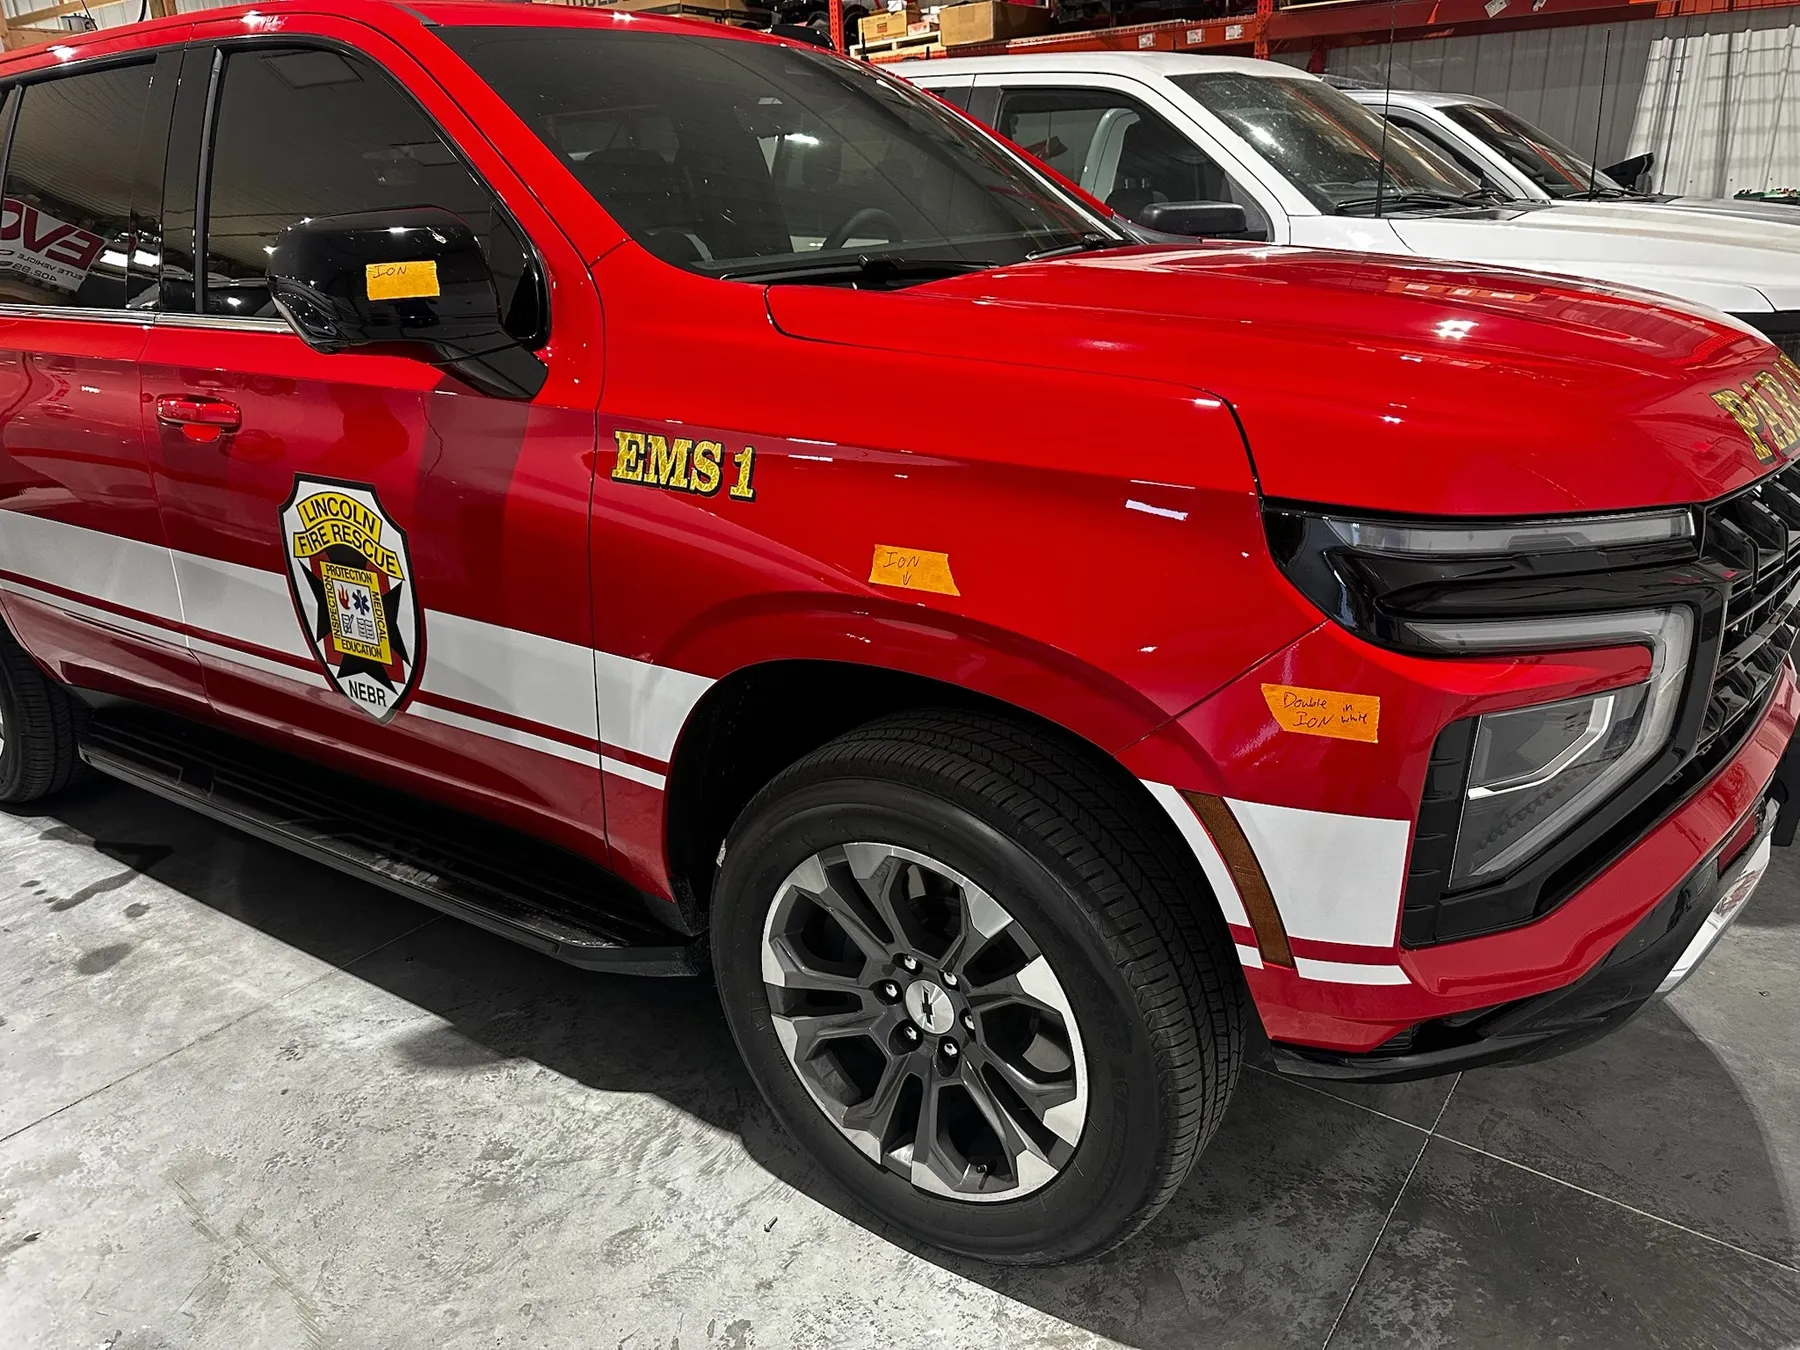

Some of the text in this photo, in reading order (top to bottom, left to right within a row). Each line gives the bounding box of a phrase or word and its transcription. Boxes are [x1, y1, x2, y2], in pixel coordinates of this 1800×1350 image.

[373, 265, 407, 279] ION
[611, 429, 756, 502] EMS 1
[302, 497, 376, 535] LINCOLN
[297, 523, 397, 576] FIRE RESCUE
[883, 551, 920, 569] ION
[325, 563, 373, 585] PROTECTION
[323, 574, 342, 640] INSPECTION
[371, 590, 388, 643] MEDICAL
[341, 638, 383, 660] EDUCATION
[348, 679, 388, 708] NEBR
[1283, 691, 1354, 713] Double in
[1292, 711, 1335, 729] ION
